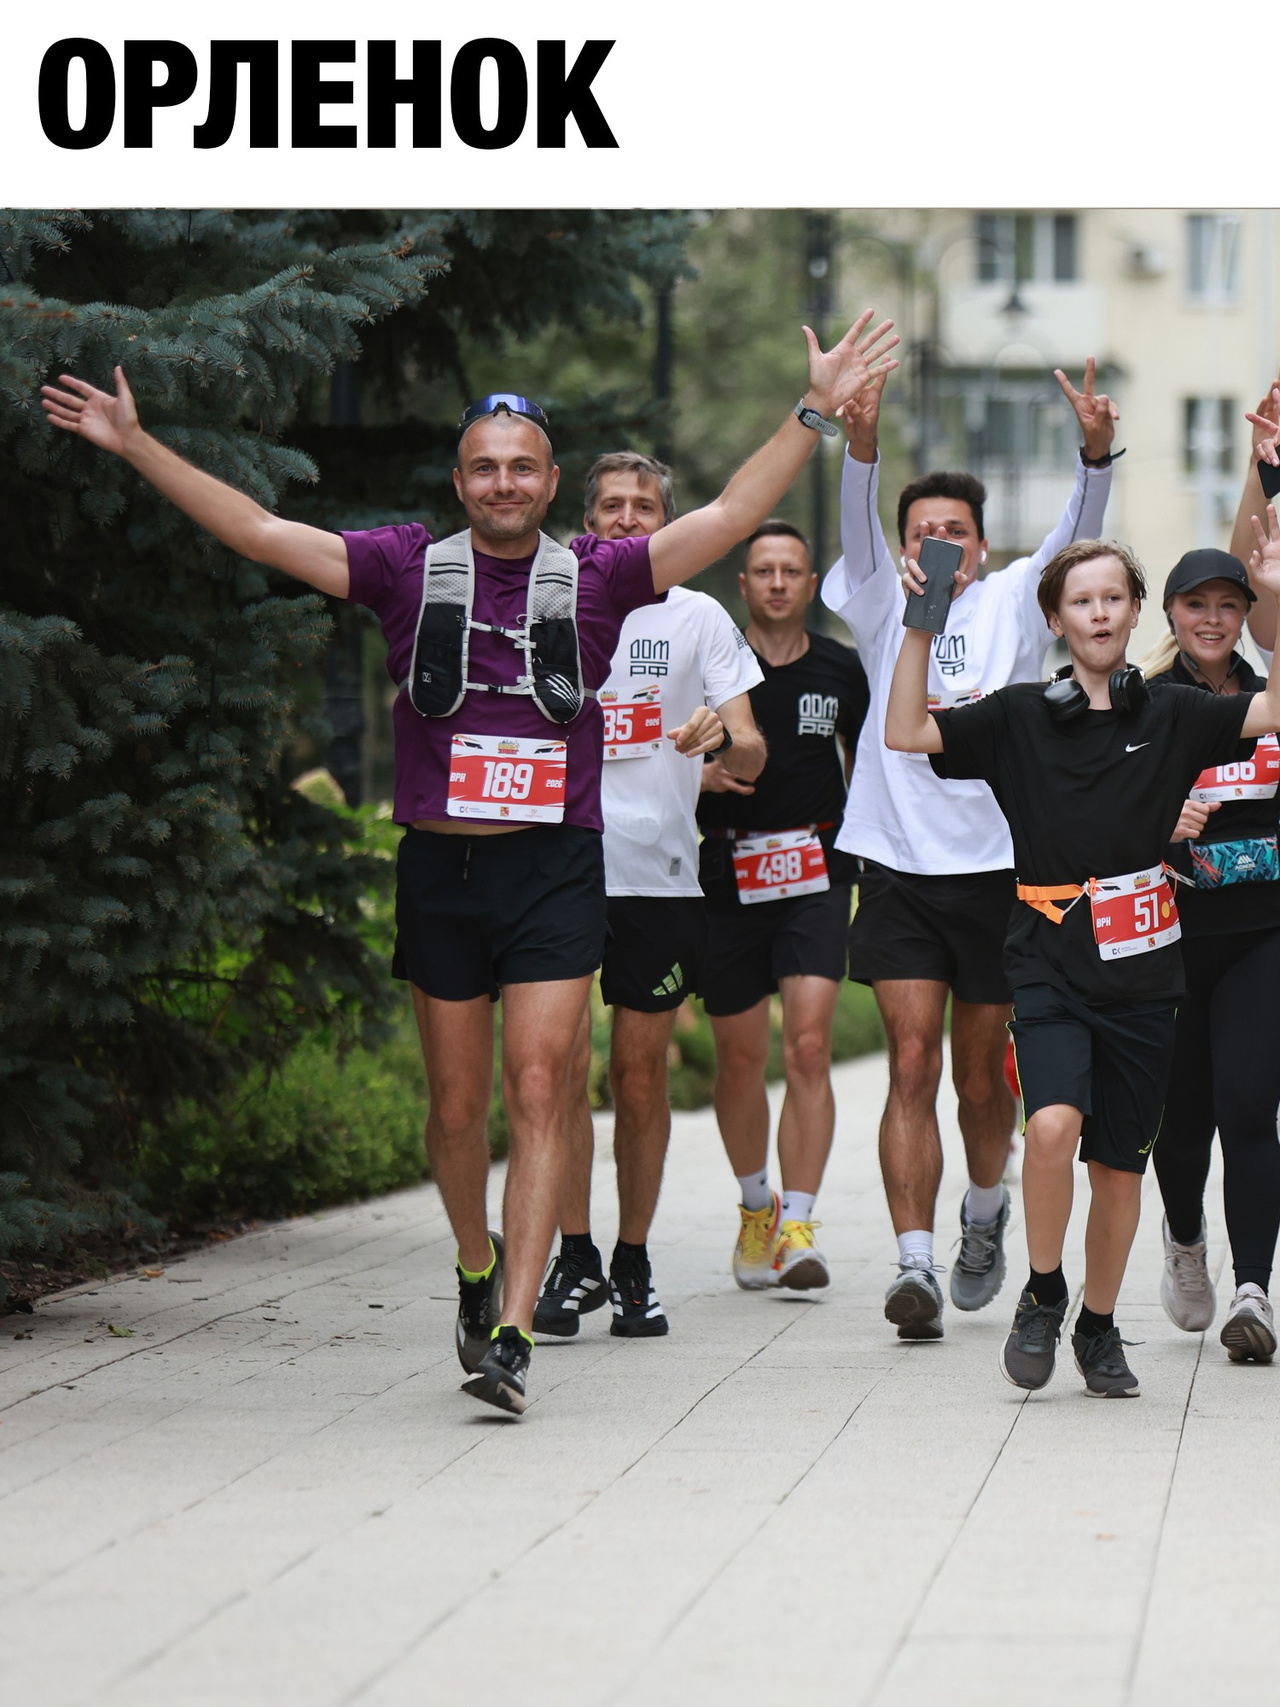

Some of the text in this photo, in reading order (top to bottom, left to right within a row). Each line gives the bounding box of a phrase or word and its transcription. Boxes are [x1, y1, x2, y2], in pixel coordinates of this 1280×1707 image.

[933, 634, 966, 660] ОМ
[481, 761, 535, 800] 189
[545, 779, 563, 789] 2026
[756, 850, 803, 885] 498
[1134, 892, 1159, 933] 51
